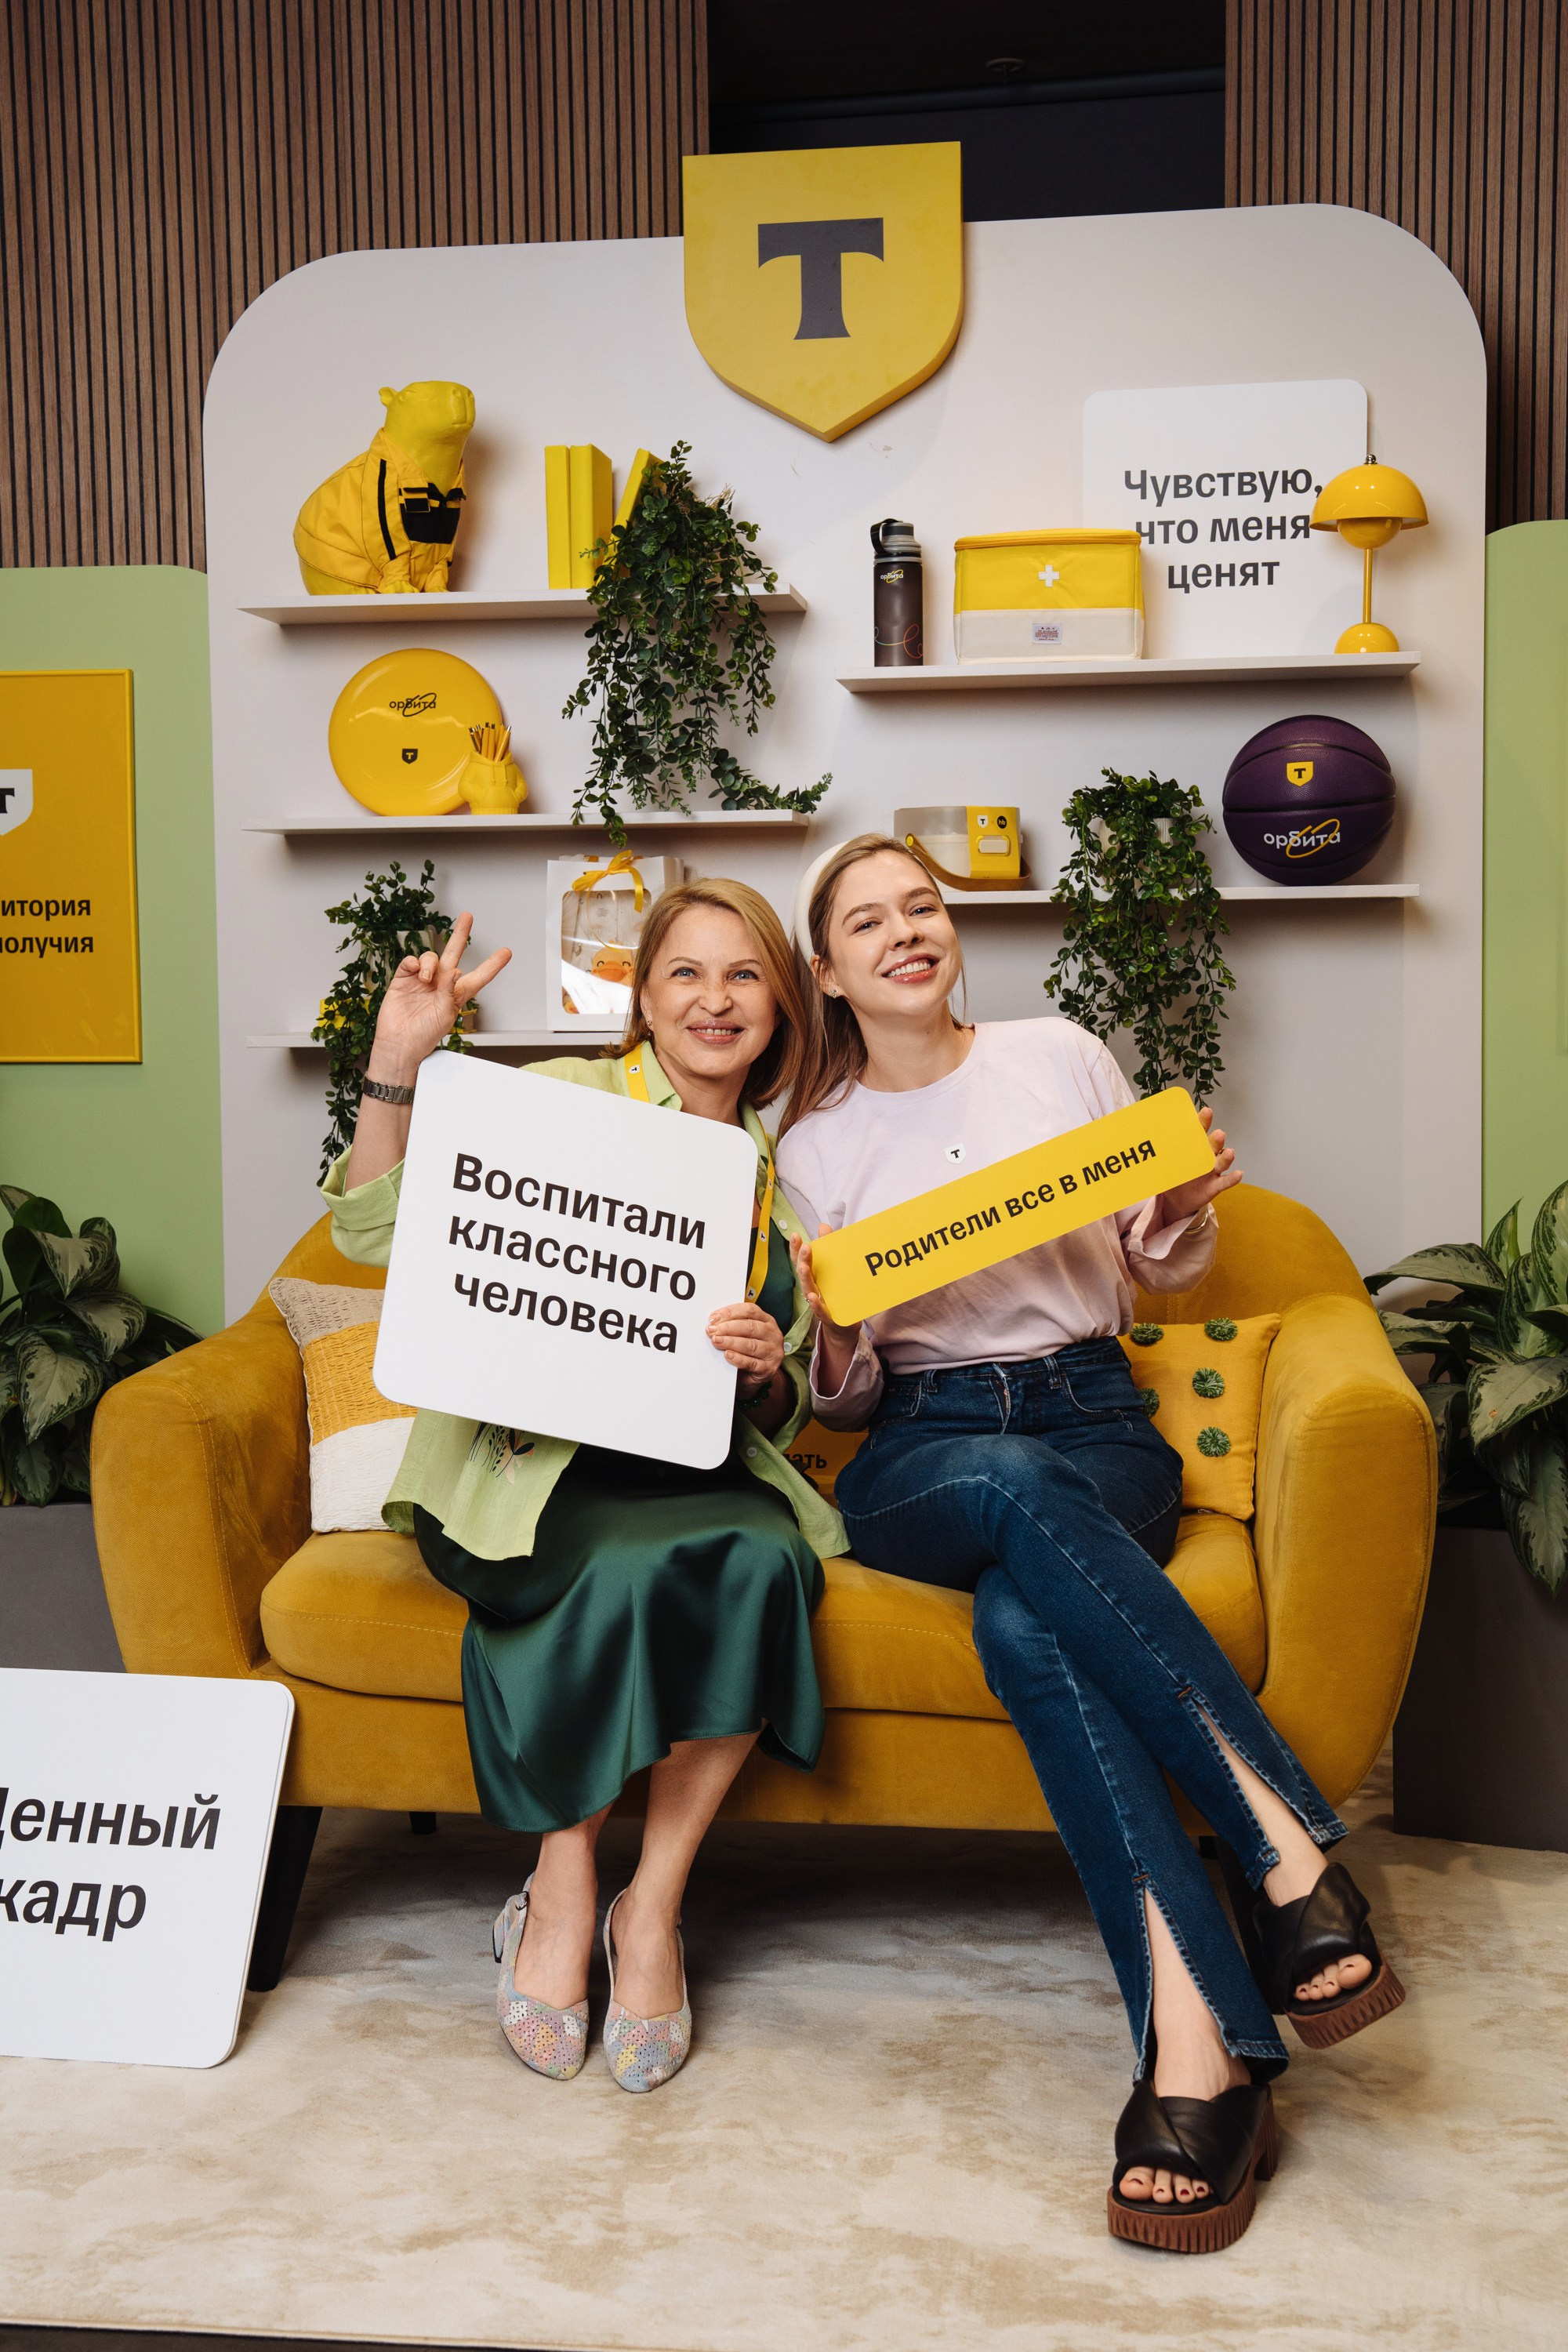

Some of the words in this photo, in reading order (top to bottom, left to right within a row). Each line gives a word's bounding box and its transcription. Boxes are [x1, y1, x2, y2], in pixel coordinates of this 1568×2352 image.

[1124, 469, 1323, 507] Чувствую,
[1135, 519, 1199, 545] что
[1210, 514, 1310, 543] меня
[1168, 561, 1280, 594] ценят
[452, 1152, 706, 1250] Воспитали
[864, 1206, 1001, 1276] Родители
[1004, 1184, 1055, 1218] все
[1058, 1174, 1078, 1195] в
[1082, 1140, 1156, 1185] меня
[448, 1215, 696, 1301] классного
[454, 1273, 677, 1354] человека
[0, 1878, 147, 1942] кадр
